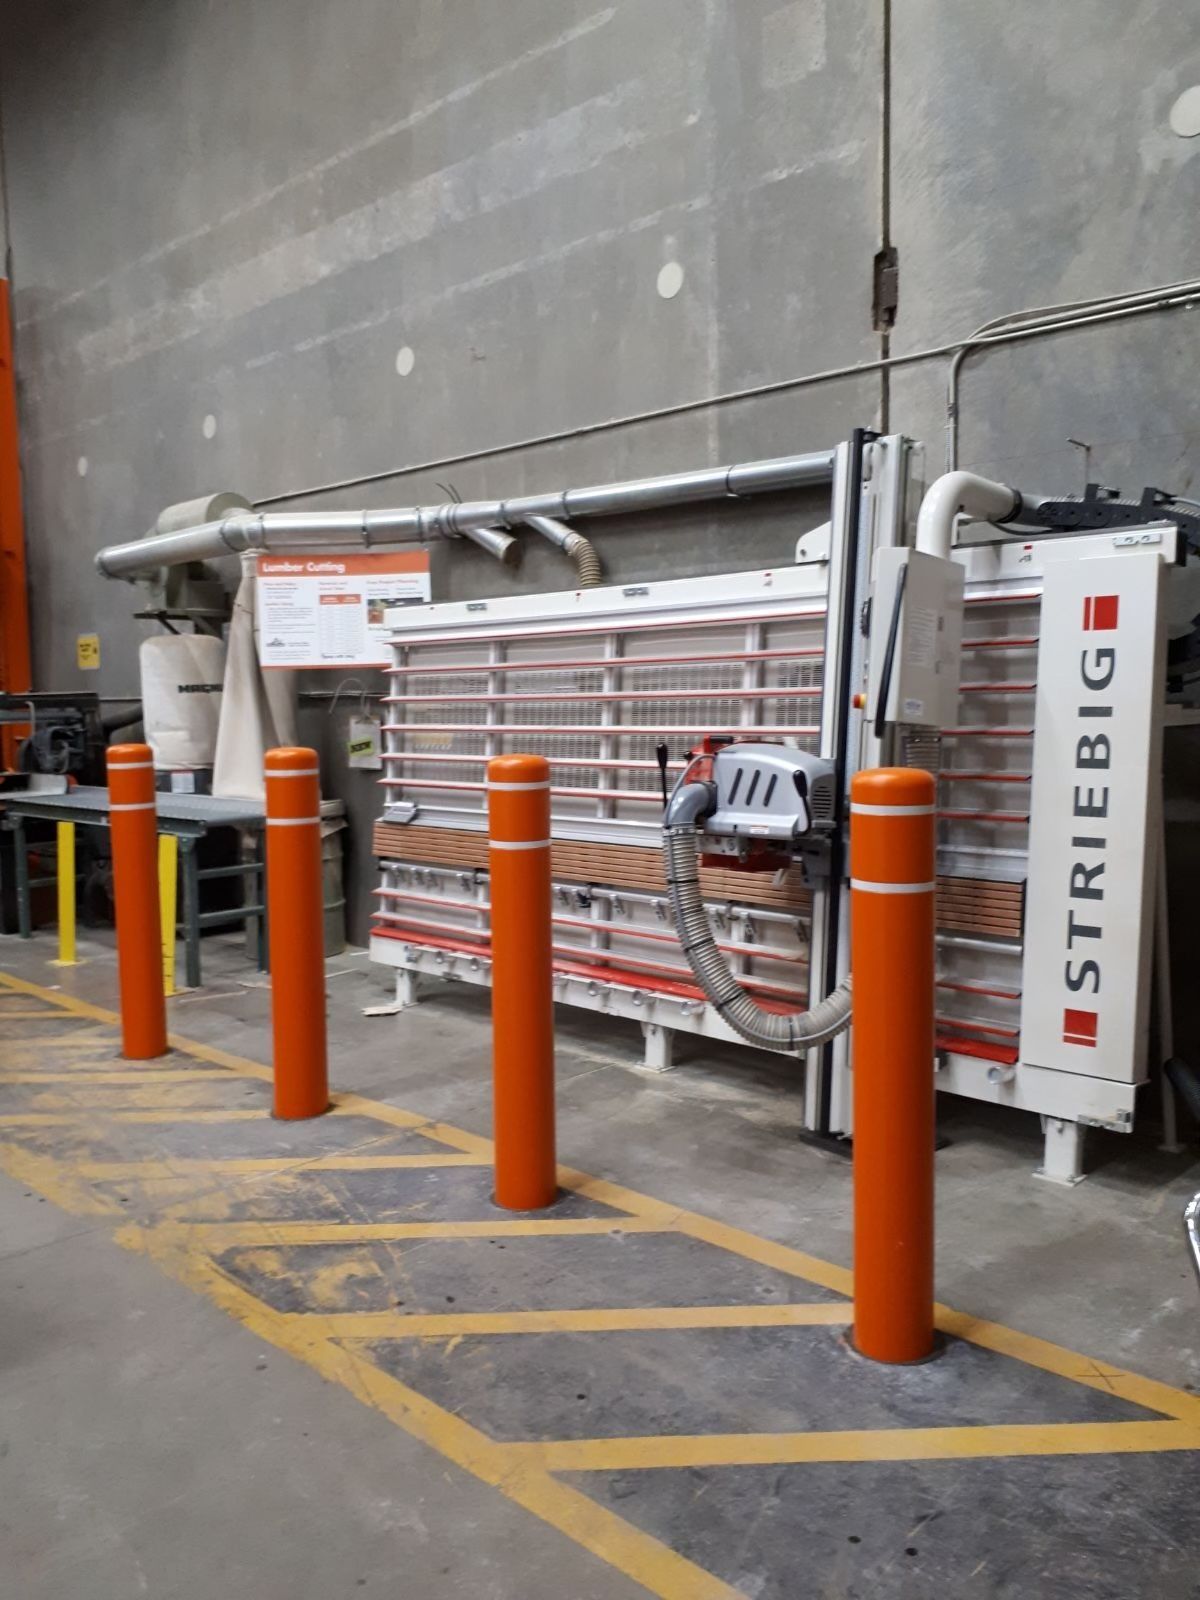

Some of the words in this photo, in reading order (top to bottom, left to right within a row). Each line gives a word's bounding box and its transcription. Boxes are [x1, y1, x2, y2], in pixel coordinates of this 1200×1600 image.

[262, 562, 304, 573] Lumber
[307, 561, 346, 574] Cutting
[1064, 647, 1118, 994] STRIEBIG
